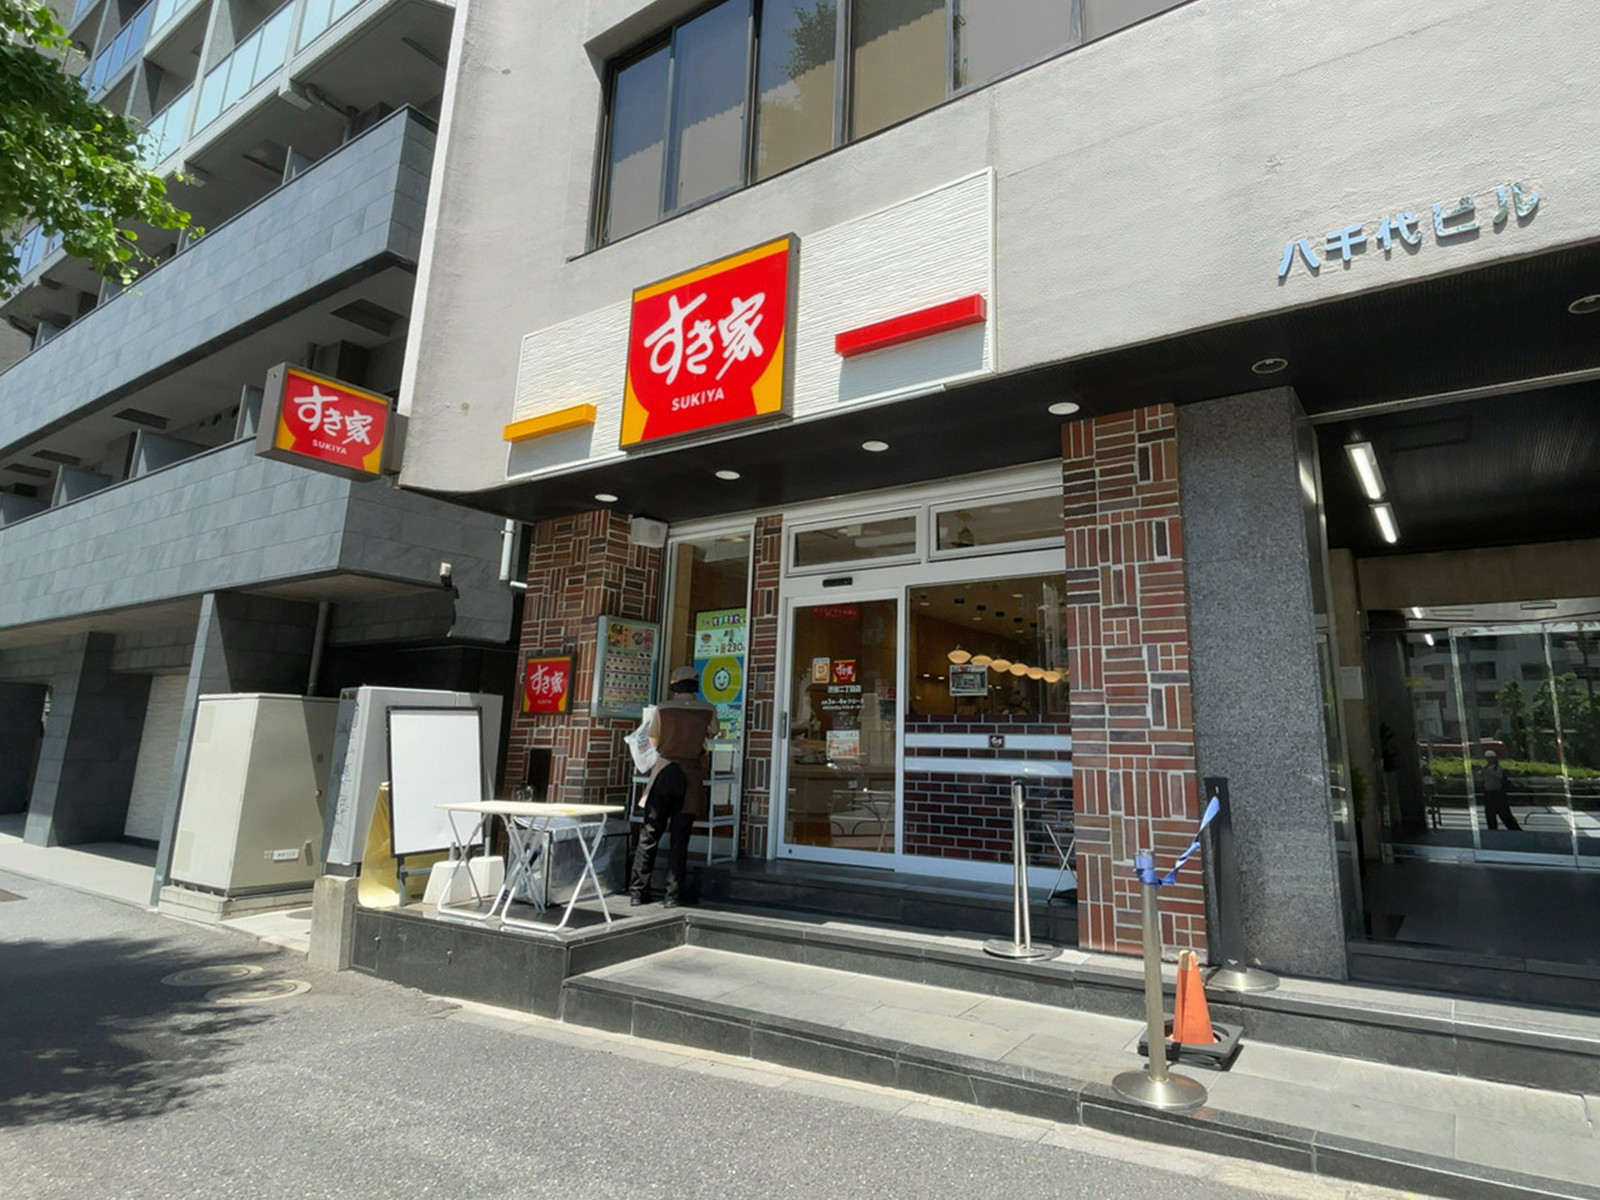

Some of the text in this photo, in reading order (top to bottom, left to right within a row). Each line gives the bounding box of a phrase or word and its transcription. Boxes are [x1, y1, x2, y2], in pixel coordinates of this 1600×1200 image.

[1278, 182, 1542, 277] 八千代ビル
[643, 292, 765, 386] すき家
[293, 385, 373, 445] すき家
[671, 387, 725, 411] SUKIYA
[312, 439, 347, 455] SUKIYA
[530, 664, 564, 698] すき家
